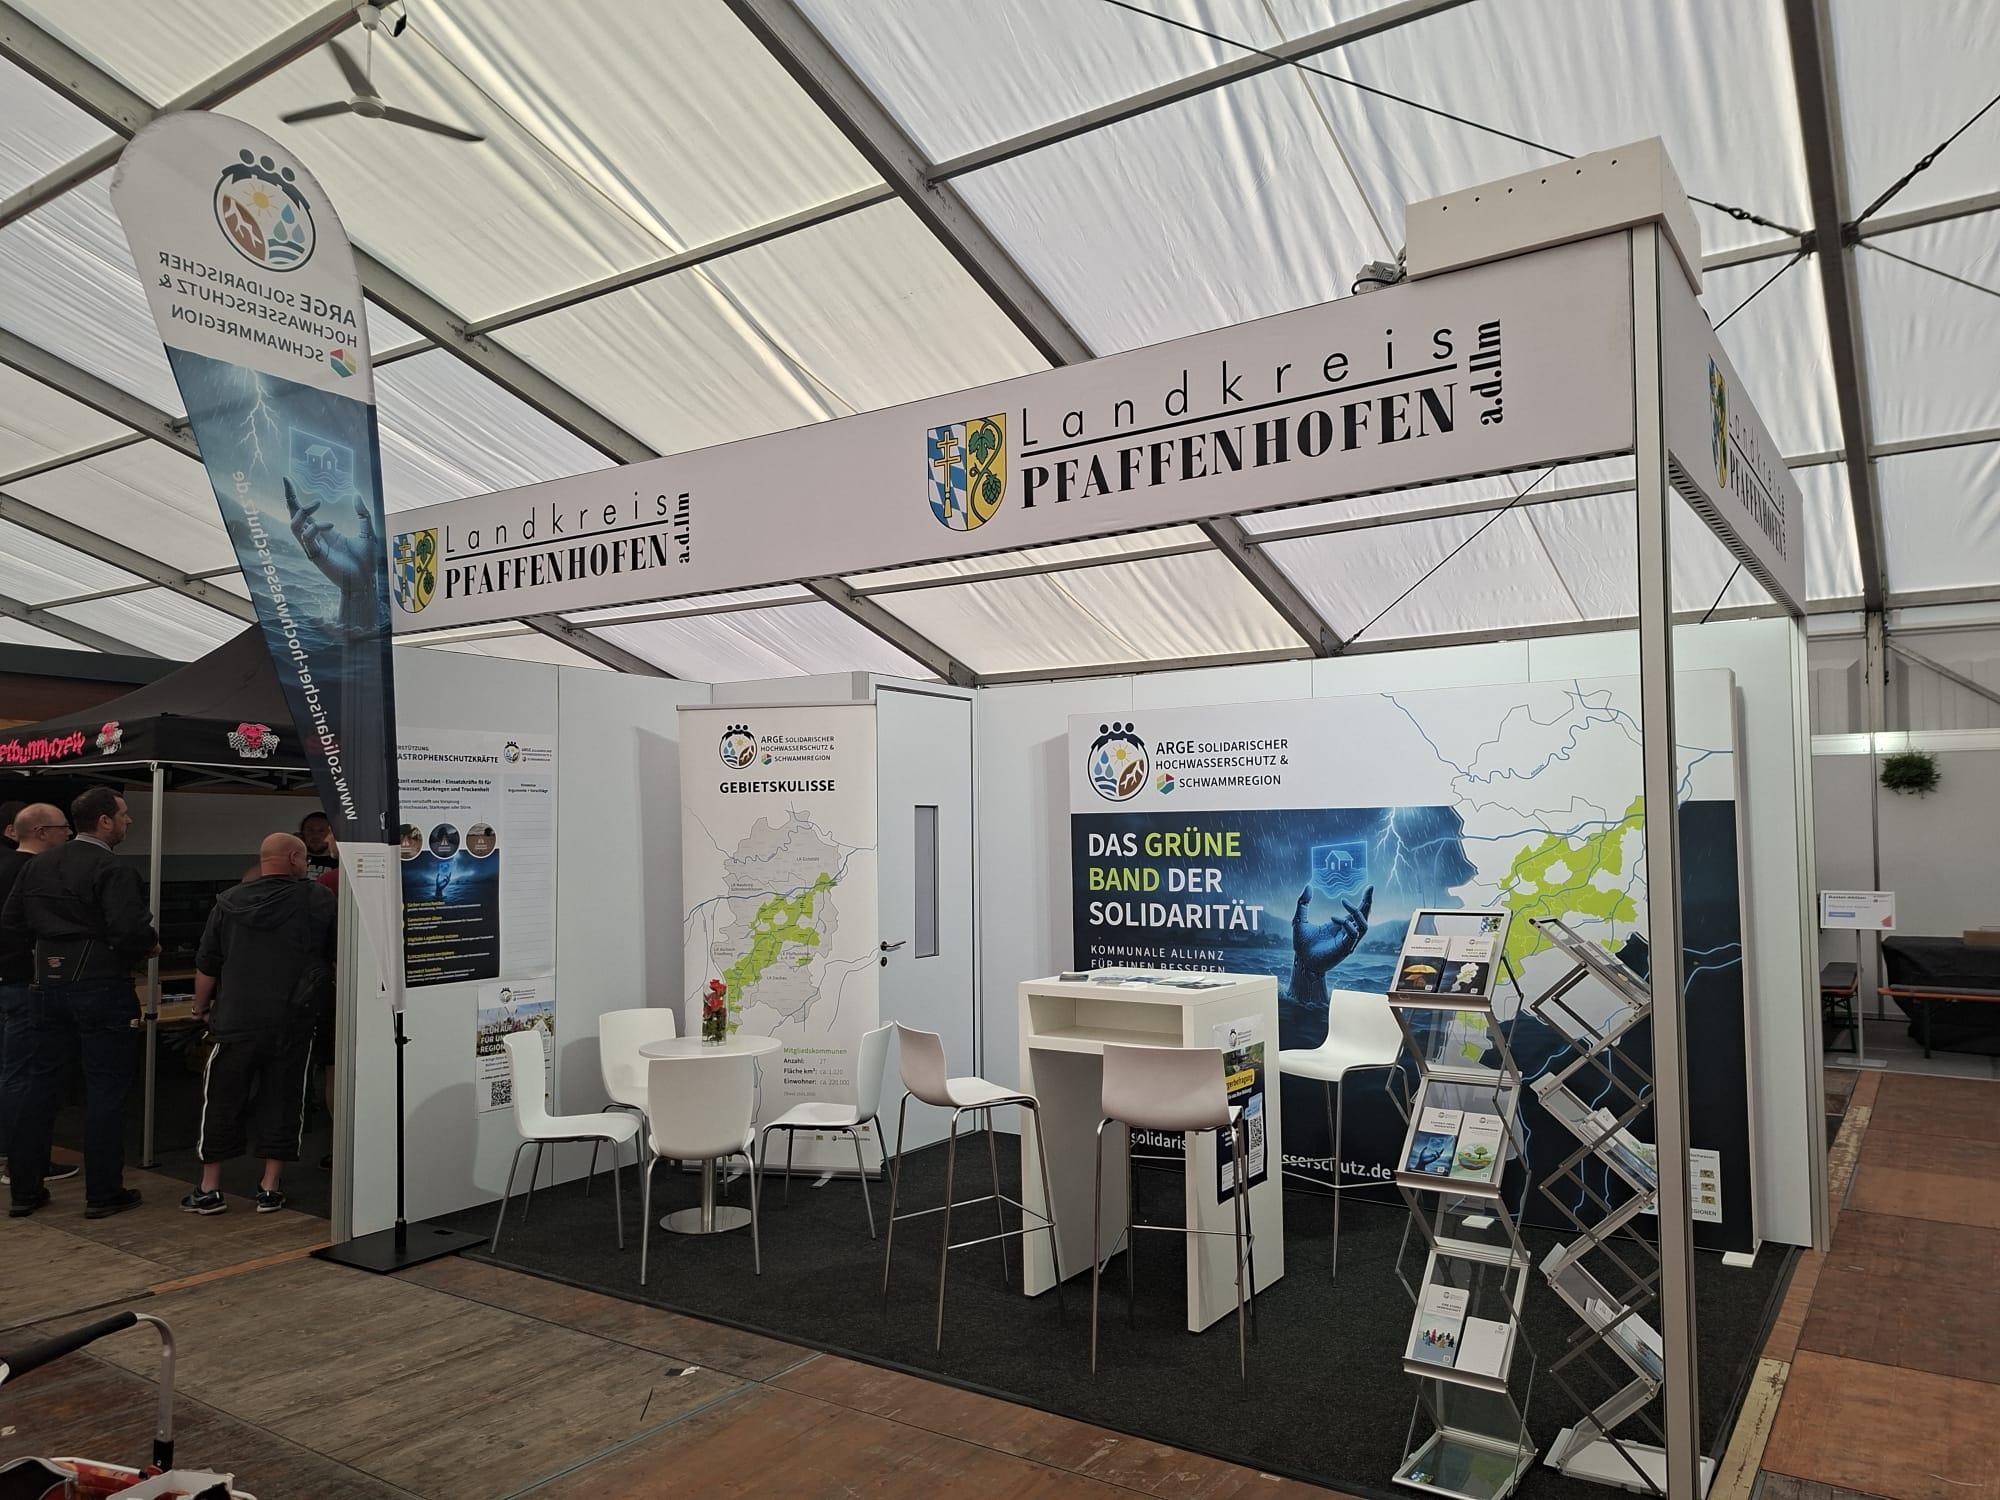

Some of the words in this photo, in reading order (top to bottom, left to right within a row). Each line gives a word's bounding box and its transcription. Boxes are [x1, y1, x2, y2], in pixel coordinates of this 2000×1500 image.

[1469, 318, 1504, 427] a.d.Ilm
[1022, 326, 1455, 445] Landkreis
[1020, 382, 1458, 510] PFAFFENHOFEN
[1728, 387, 1782, 507] Landkreis
[1730, 447, 1784, 558] PFAFFENHOFEN
[446, 491, 668, 553] Landkreis
[674, 492, 690, 564] a.d.Ilm
[445, 532, 669, 600] PFAFFENHOFEN
[760, 744, 828, 752] HOCHWASSERSCHUTZ
[761, 735, 783, 744] ARGE
[785, 735, 834, 743] SOLIDARISCHER
[1156, 741, 1195, 755] ARGE
[1198, 738, 1288, 753] SOLIDARISCHER
[774, 754, 831, 762] SCHWAMMREGION
[1155, 755, 1277, 770] HOCHWASSERSCHUTZ
[1280, 754, 1289, 765] &
[719, 780, 836, 793] GEBIETSKULISSE
[1179, 774, 1281, 788] SCHWAMMREGION
[1088, 833, 1138, 857] DAS
[1144, 826, 1241, 857] GRÜNE
[1089, 867, 1160, 892] BAND
[1168, 867, 1223, 893] DER
[1088, 899, 1264, 931] SOLIDARITÄT
[1090, 944, 1166, 958] KOMMUNALE
[1170, 948, 1224, 961] ALLIANZ
[1091, 957, 1112, 969] FÜR
[1118, 960, 1155, 969] EINEN
[480, 1034, 494, 1044] FÜR
[783, 1067, 802, 1075] Fläche
[783, 1077, 817, 1086] Einwohner:
